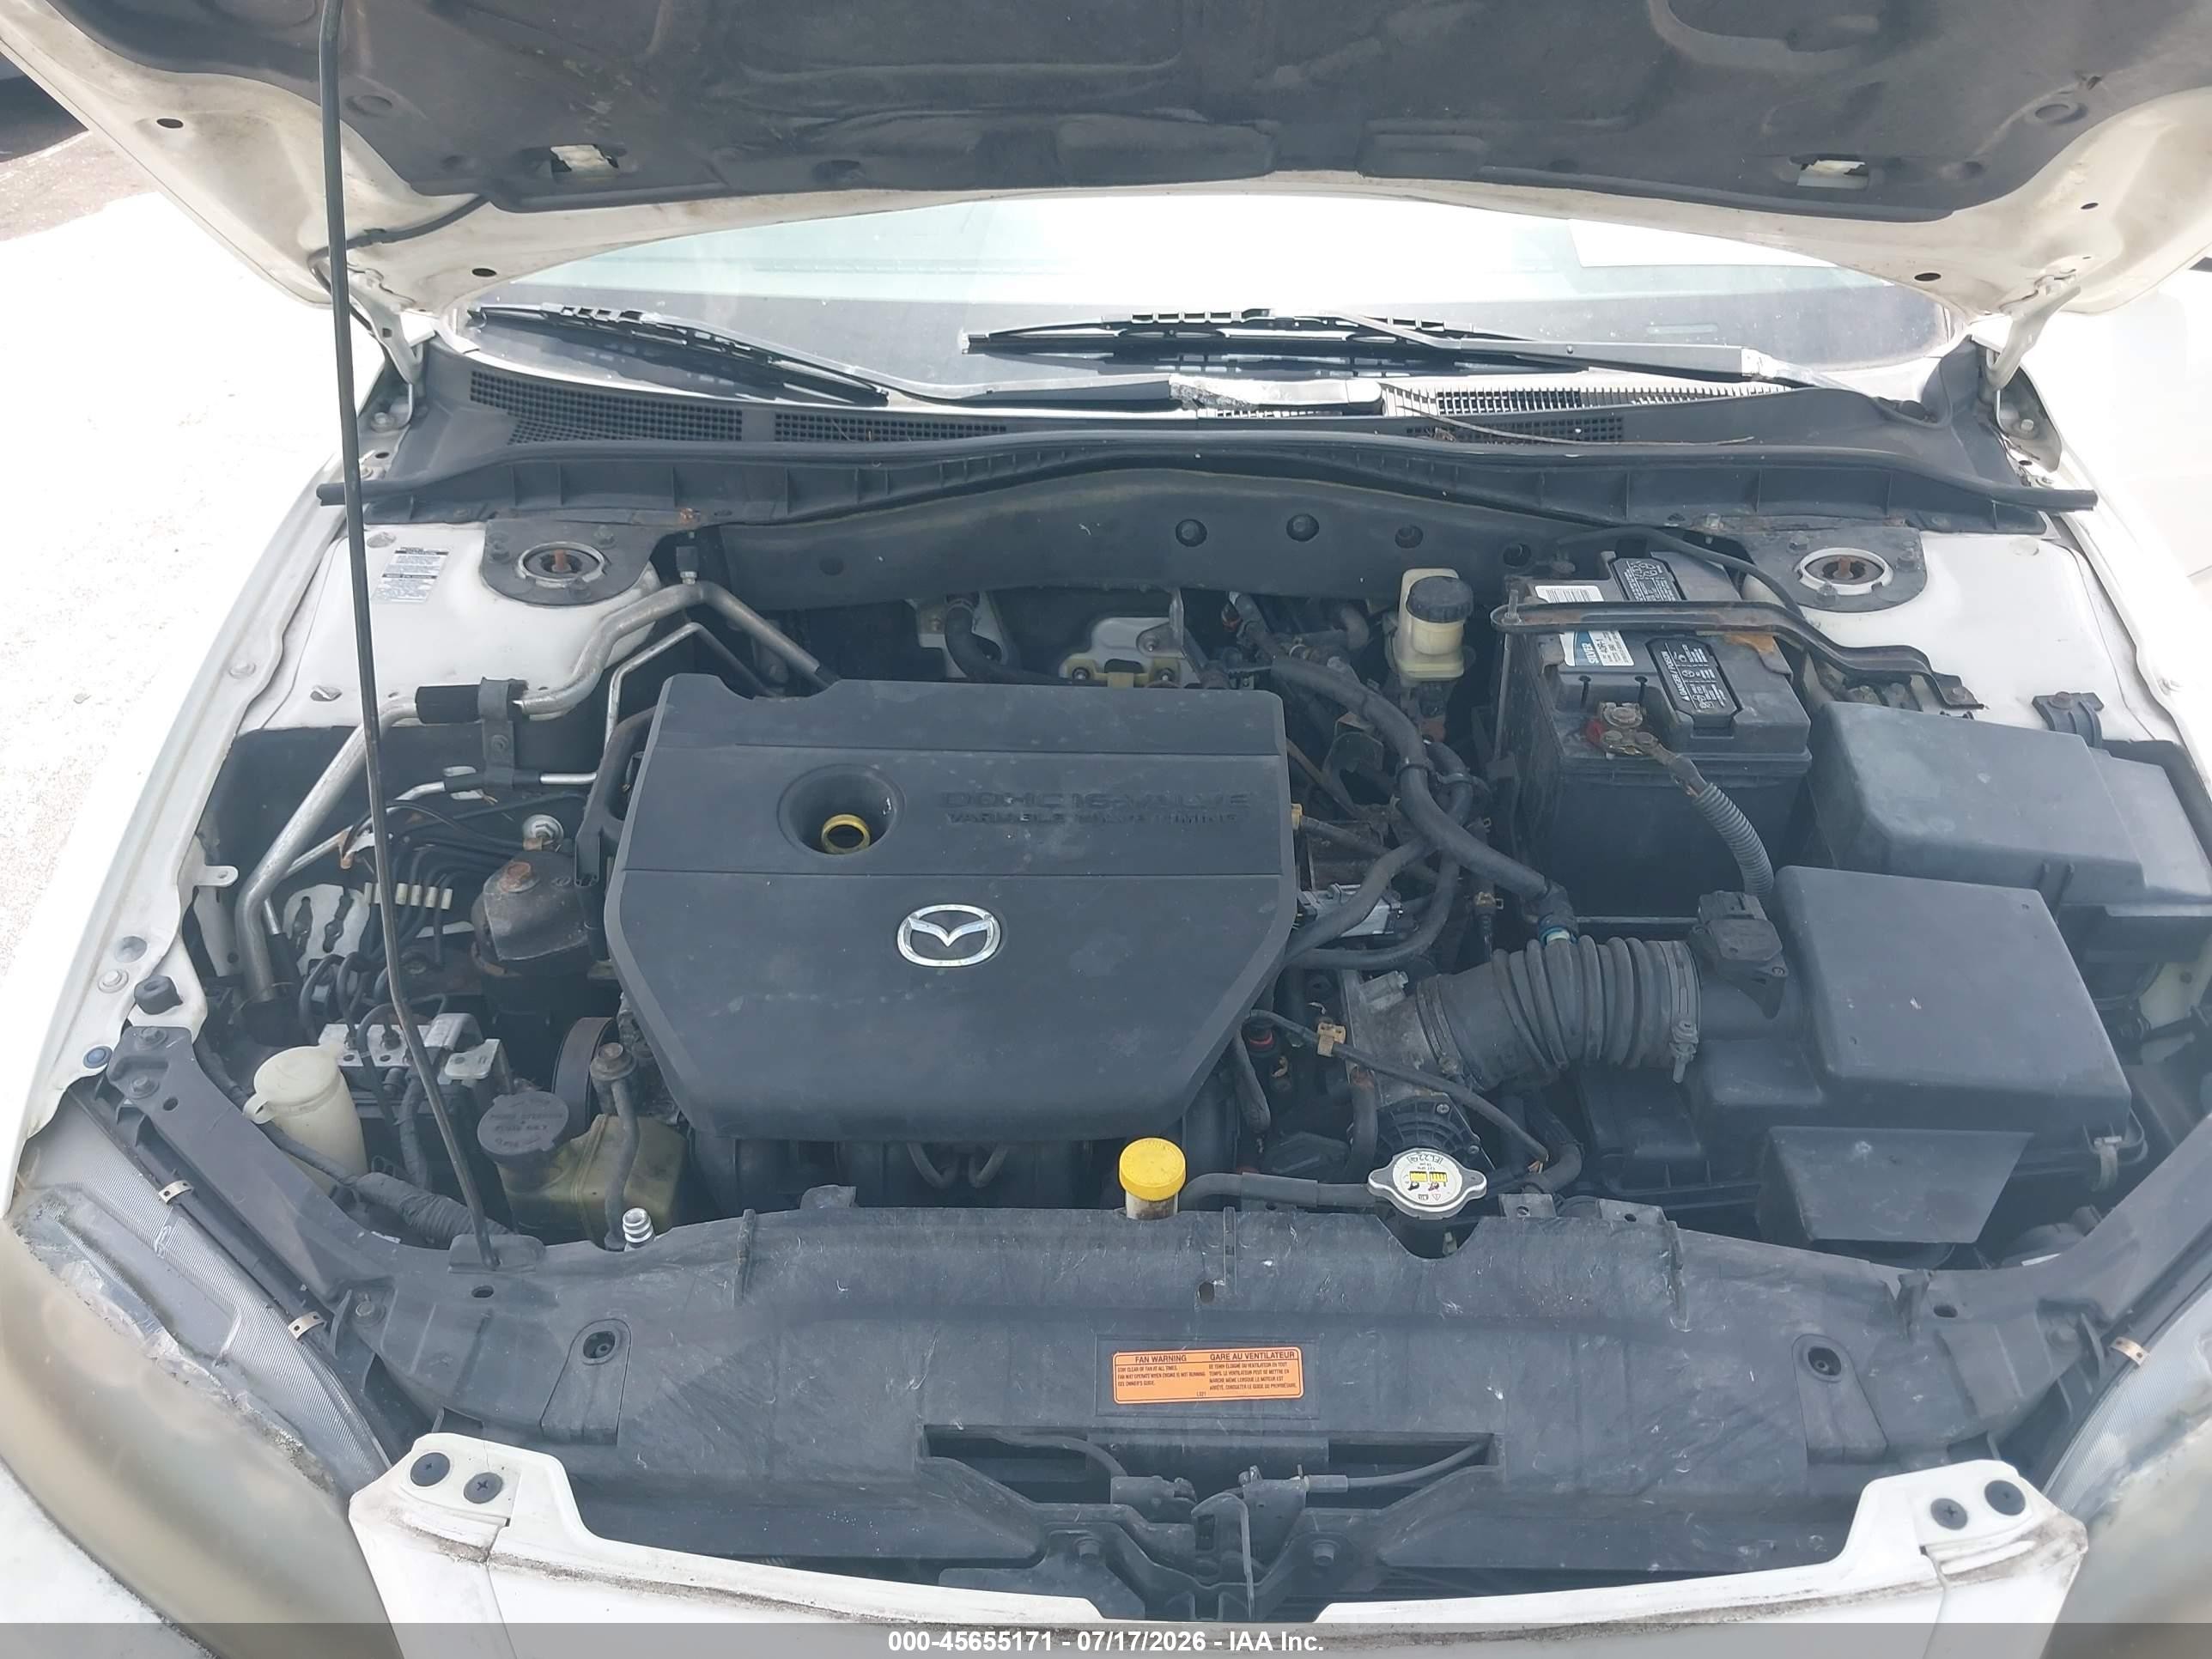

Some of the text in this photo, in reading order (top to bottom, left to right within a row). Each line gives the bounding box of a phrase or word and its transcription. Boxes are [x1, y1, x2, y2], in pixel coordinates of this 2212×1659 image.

[1152, 1354, 1187, 1363] WARNING
[1210, 1352, 1231, 1361] GARE
[1244, 1351, 1295, 1360] VENTILATEUR
